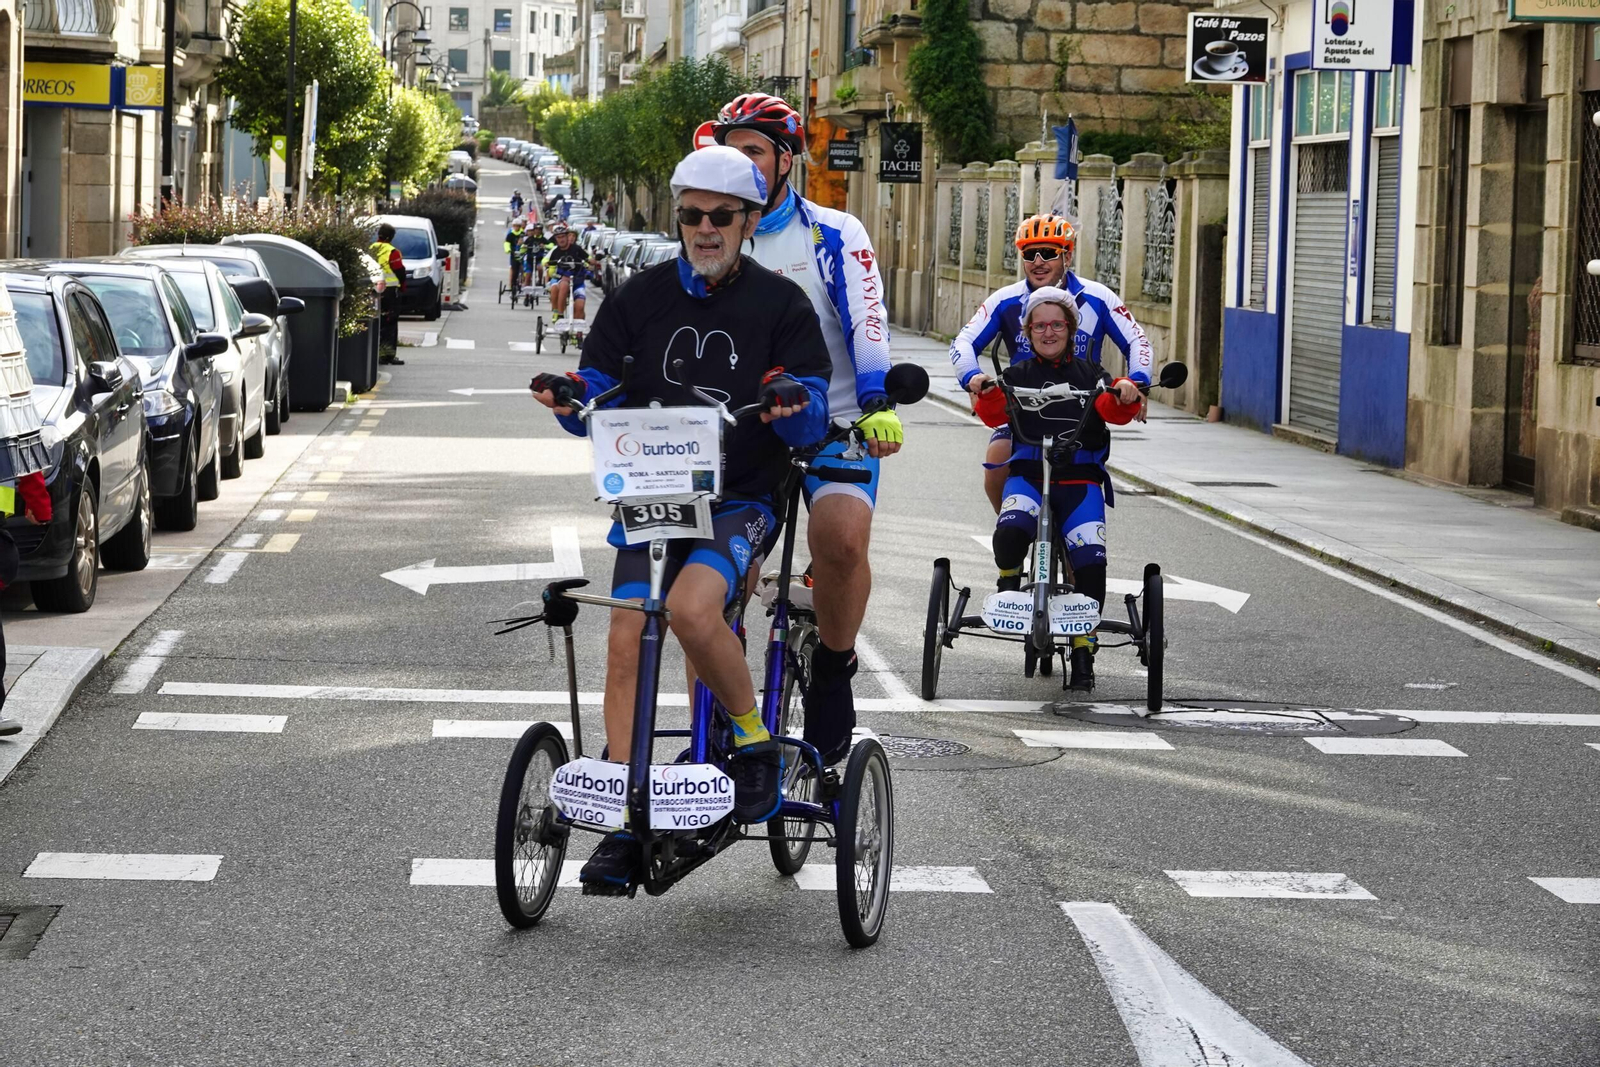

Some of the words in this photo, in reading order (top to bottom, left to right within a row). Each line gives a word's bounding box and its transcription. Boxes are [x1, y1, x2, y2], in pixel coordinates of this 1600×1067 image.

[1195, 17, 1219, 29] Café
[1221, 18, 1241, 29] Bar
[1228, 30, 1265, 42] Pazos
[1324, 37, 1355, 46] Loterías
[1357, 39, 1363, 48] y
[1324, 46, 1360, 56] Apuestas
[1362, 47, 1375, 56] del
[1323, 56, 1351, 65] Estado
[23, 78, 76, 96] RREOS
[829, 149, 858, 157] ARRECIFE
[880, 160, 922, 172] TACHE
[642, 441, 700, 456] turbo10
[656, 469, 690, 477] SANTIAGO
[632, 503, 683, 523] 305
[1037, 543, 1048, 571] povisa
[997, 600, 1033, 613] turbo10
[1063, 601, 1099, 612] turbo10
[992, 618, 1025, 631] VIGO
[1061, 622, 1093, 633] VIGO
[556, 767, 625, 796] turbo10
[652, 776, 730, 796] turbo10
[552, 785, 626, 807] TURBOCOMPRENSORES
[651, 796, 731, 806] TURBOCOMPRENSORES
[554, 795, 589, 806] DISTRIBUCIÓN
[592, 802, 622, 813] REPARACIÓN
[654, 805, 692, 813] DISTRIBUCIÓN
[695, 804, 728, 812] REPARACIÓN
[569, 806, 606, 824] VIGO
[672, 814, 711, 827] VIGO
